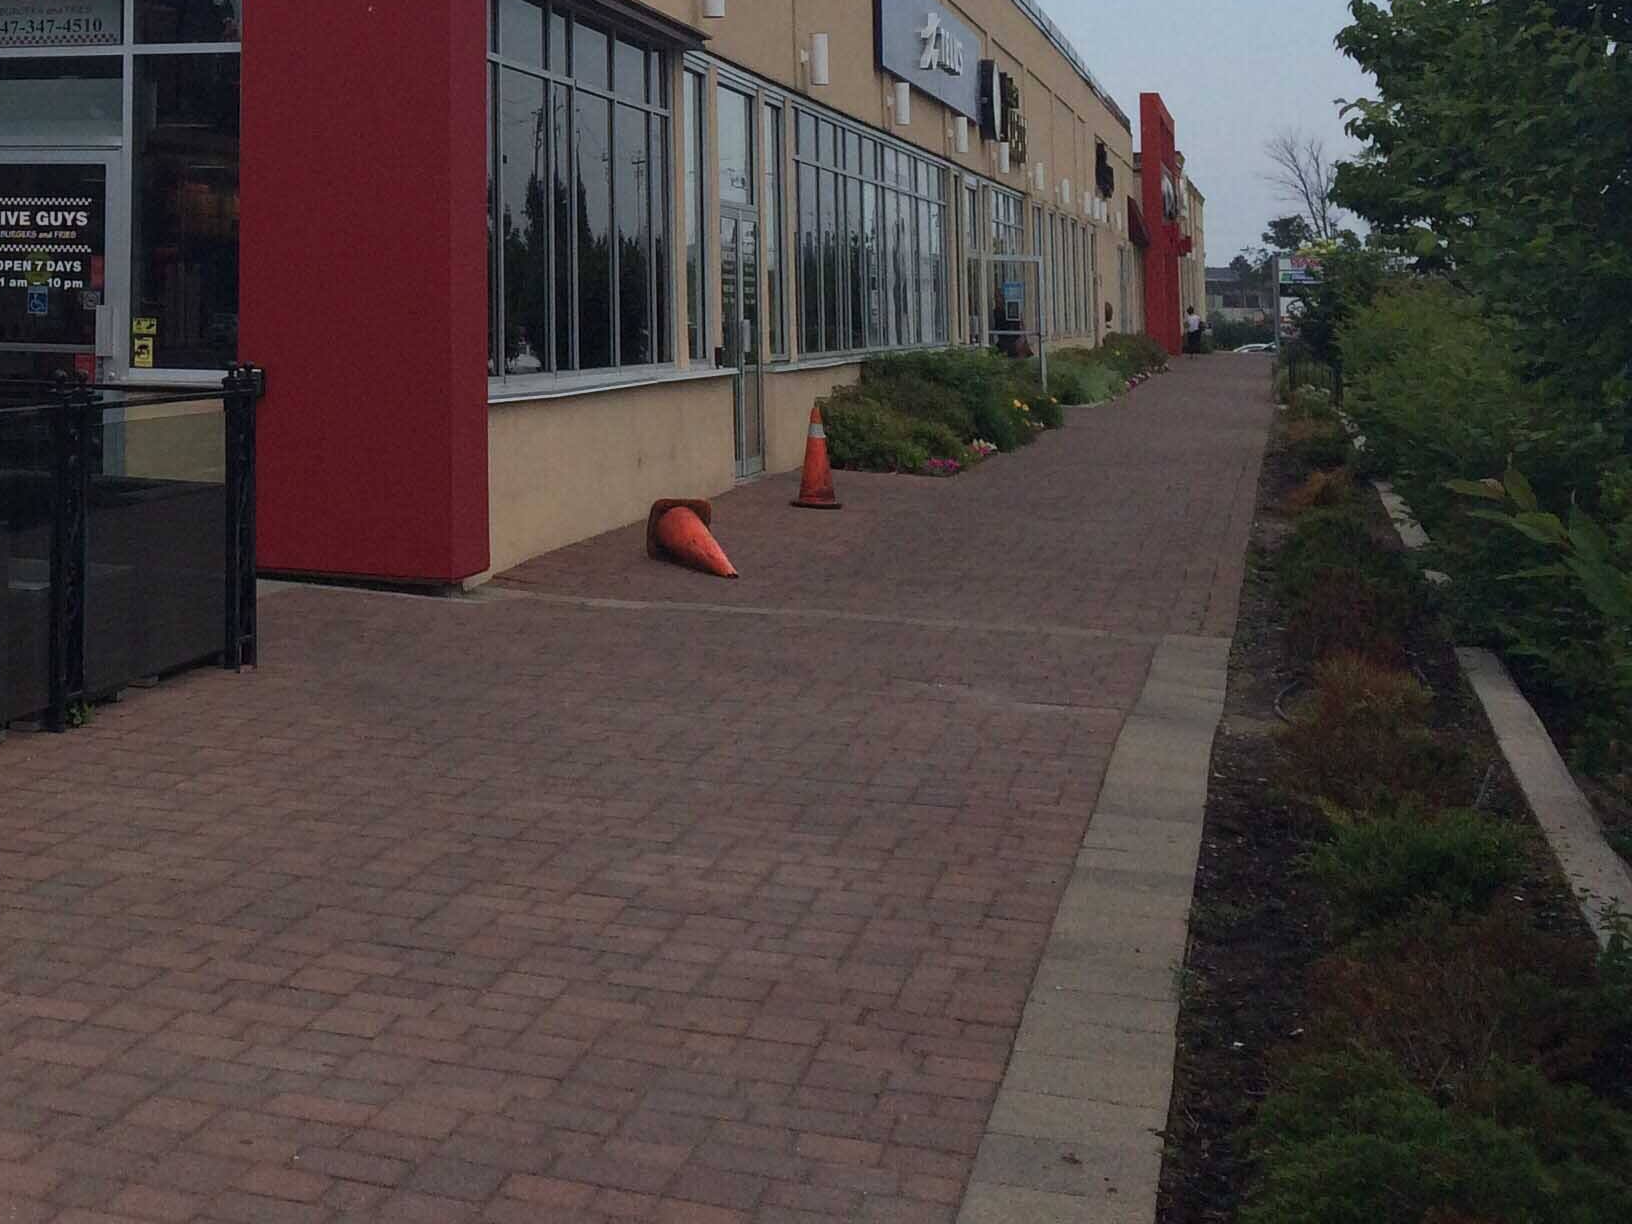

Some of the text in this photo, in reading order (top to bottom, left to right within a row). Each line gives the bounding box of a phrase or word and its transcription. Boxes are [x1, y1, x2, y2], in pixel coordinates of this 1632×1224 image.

[36, 211, 88, 226] GUYS
[35, 260, 43, 272] 7
[46, 260, 82, 272] DAYS
[9, 278, 28, 287] am
[47, 277, 61, 288] 10
[64, 279, 84, 290] pm
